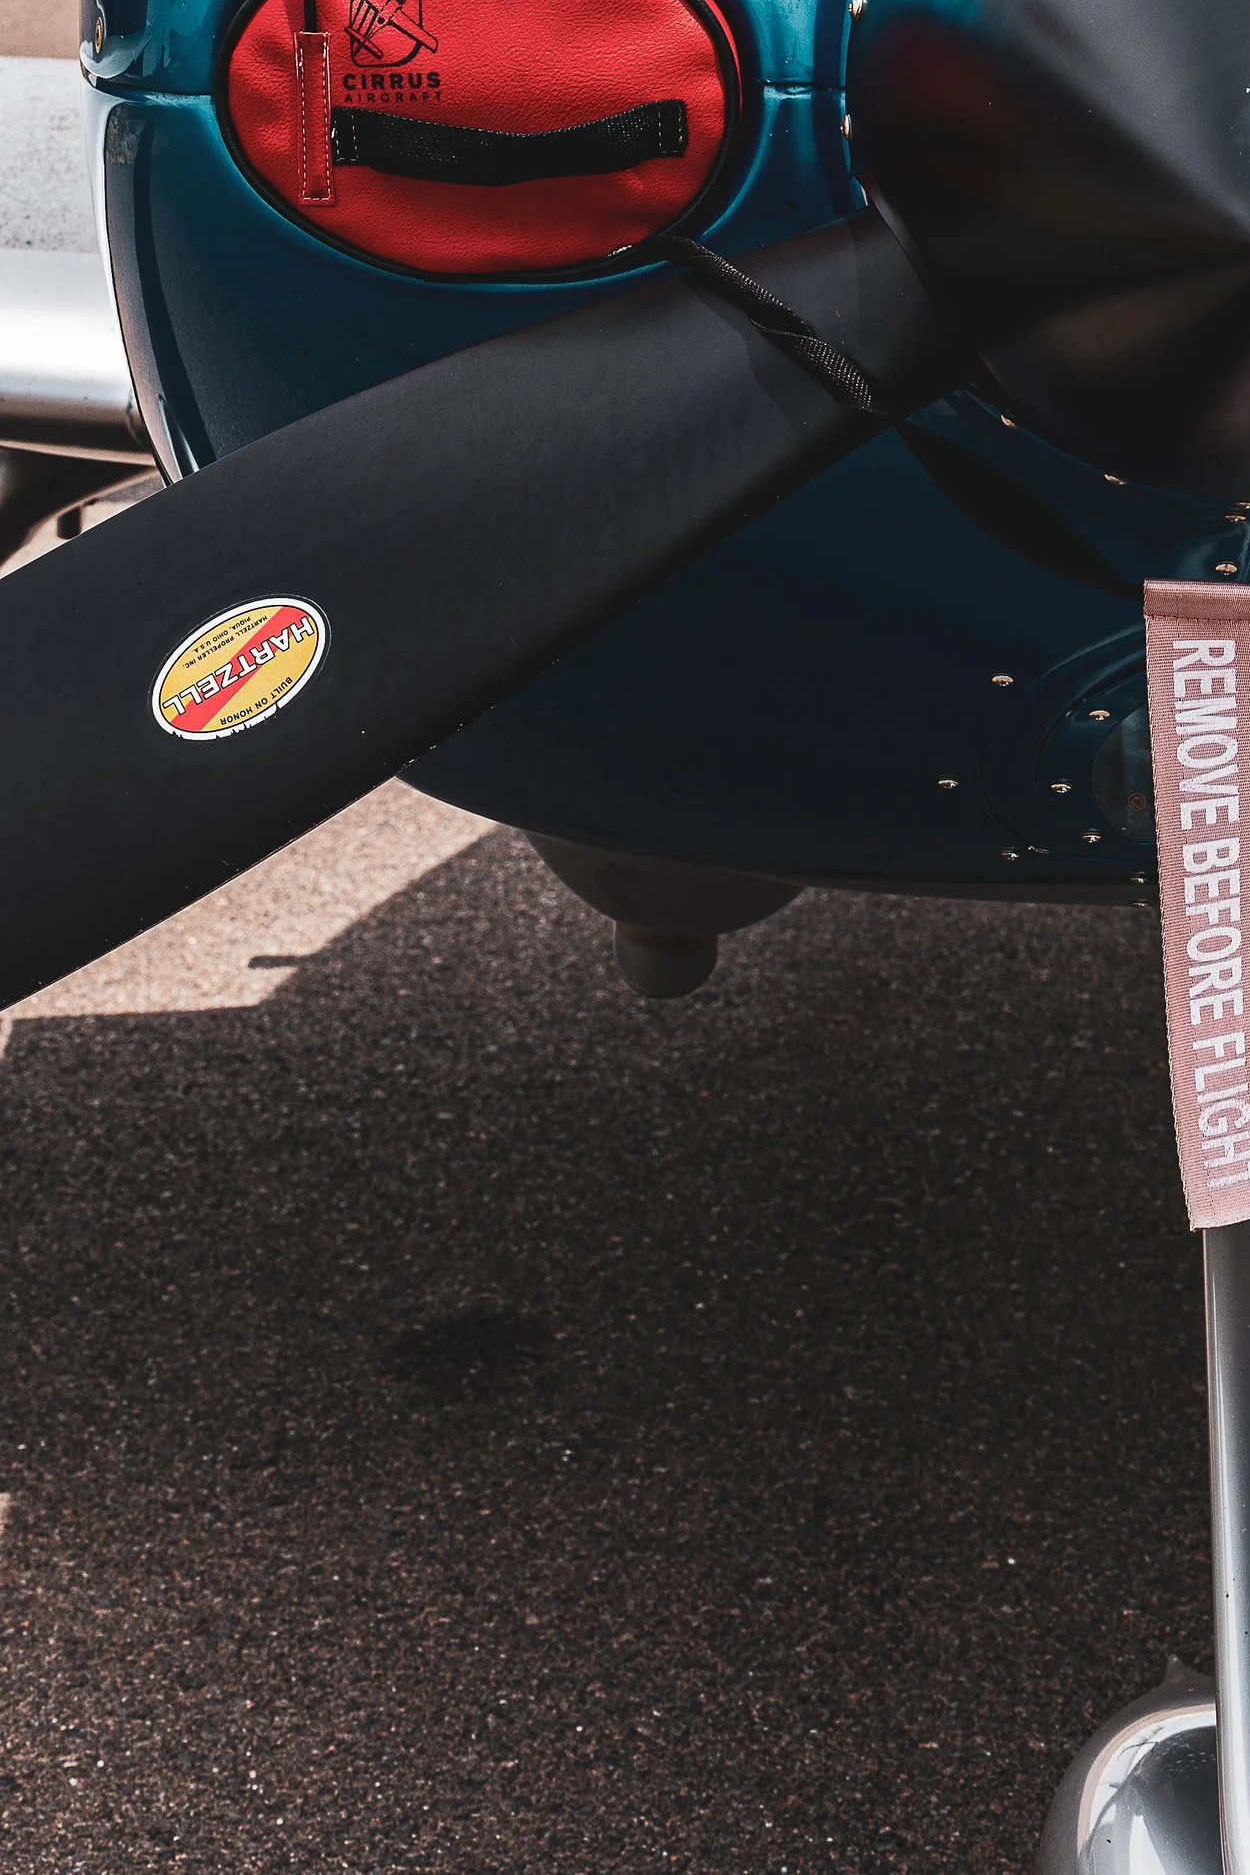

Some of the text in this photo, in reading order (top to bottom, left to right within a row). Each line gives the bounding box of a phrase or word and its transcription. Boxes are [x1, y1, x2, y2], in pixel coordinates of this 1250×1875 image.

[343, 71, 441, 91] CIRRUS
[344, 91, 442, 103] AIRCRAFT
[183, 615, 268, 669] HARTZELL PROPELLER INC.
[192, 640, 212, 653] U.S.A.
[212, 629, 229, 642] OHIO
[162, 616, 315, 715] HARTZELL
[220, 676, 293, 725] BUILT ON HONOR
[1173, 638, 1239, 831] REMOVE
[1181, 835, 1243, 1026] BEFORE
